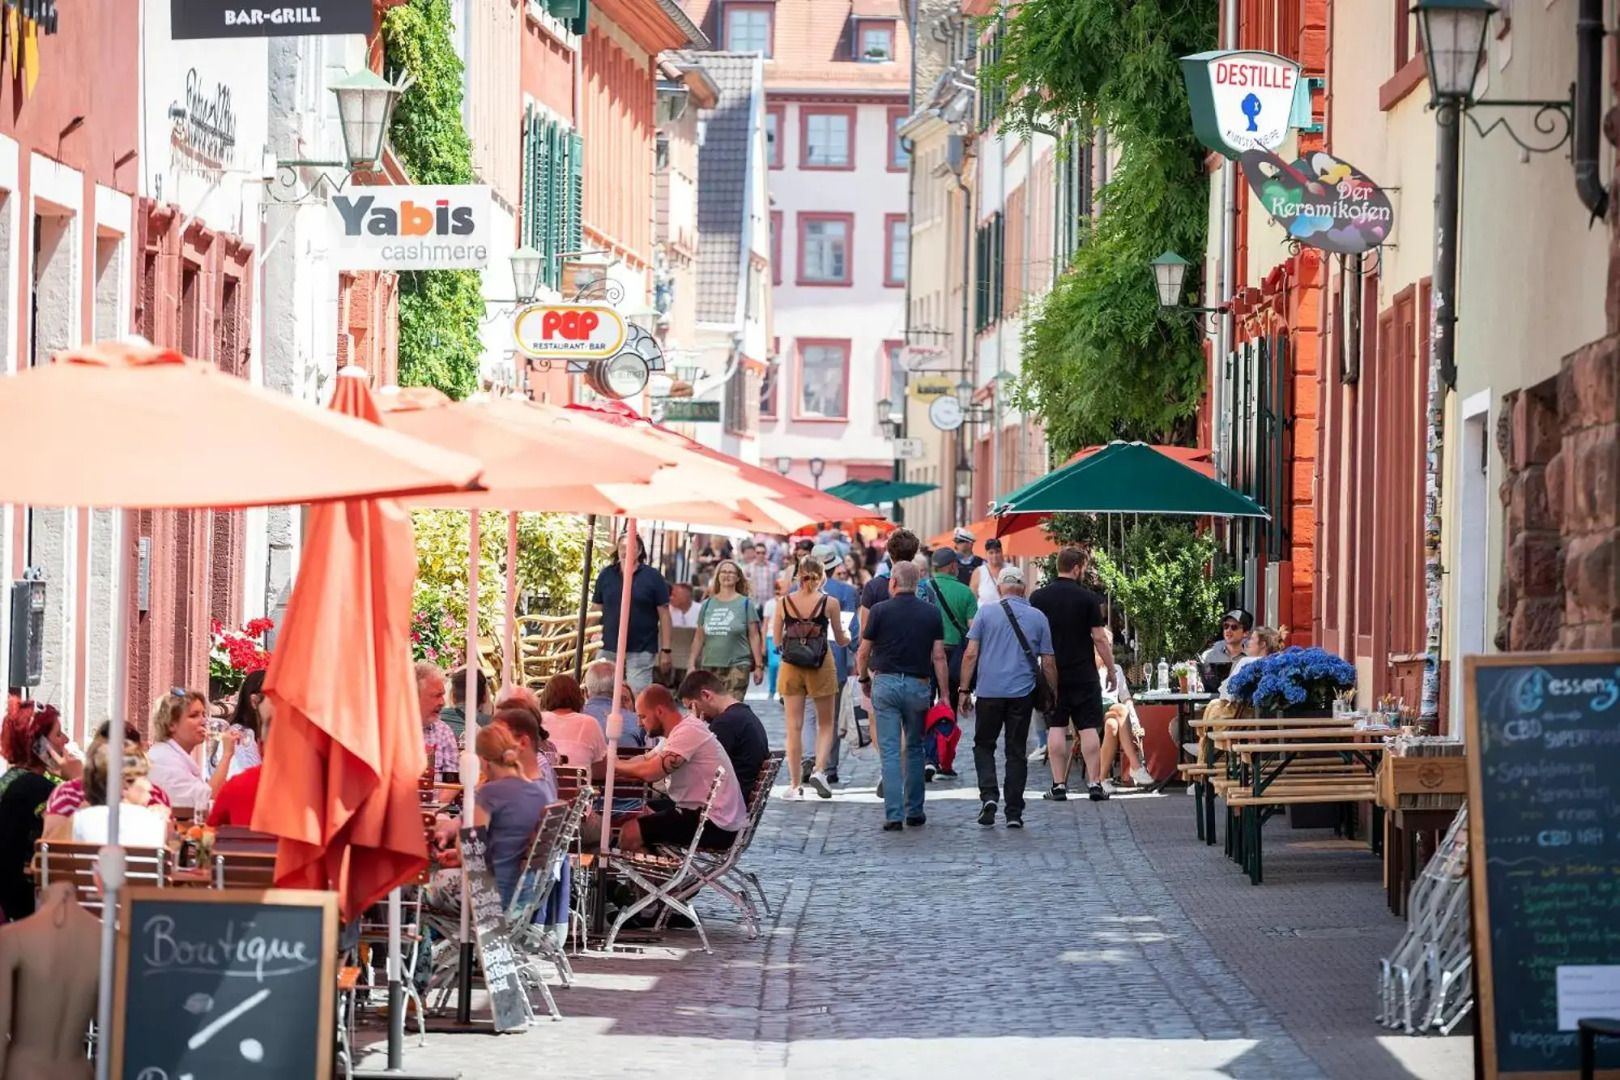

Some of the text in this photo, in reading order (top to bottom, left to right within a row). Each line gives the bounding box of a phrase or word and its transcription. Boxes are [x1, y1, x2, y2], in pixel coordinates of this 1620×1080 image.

[225, 7, 321, 25] BAR-GRILL
[1216, 63, 1292, 89] DESTILLE
[1336, 182, 1373, 202] Der
[332, 196, 475, 236] Yabis
[1272, 197, 1390, 224] Keramikofen
[381, 241, 487, 261] cashmere
[542, 310, 599, 340] POP
[1503, 718, 1542, 741] CBD
[142, 914, 318, 983] Boutique
